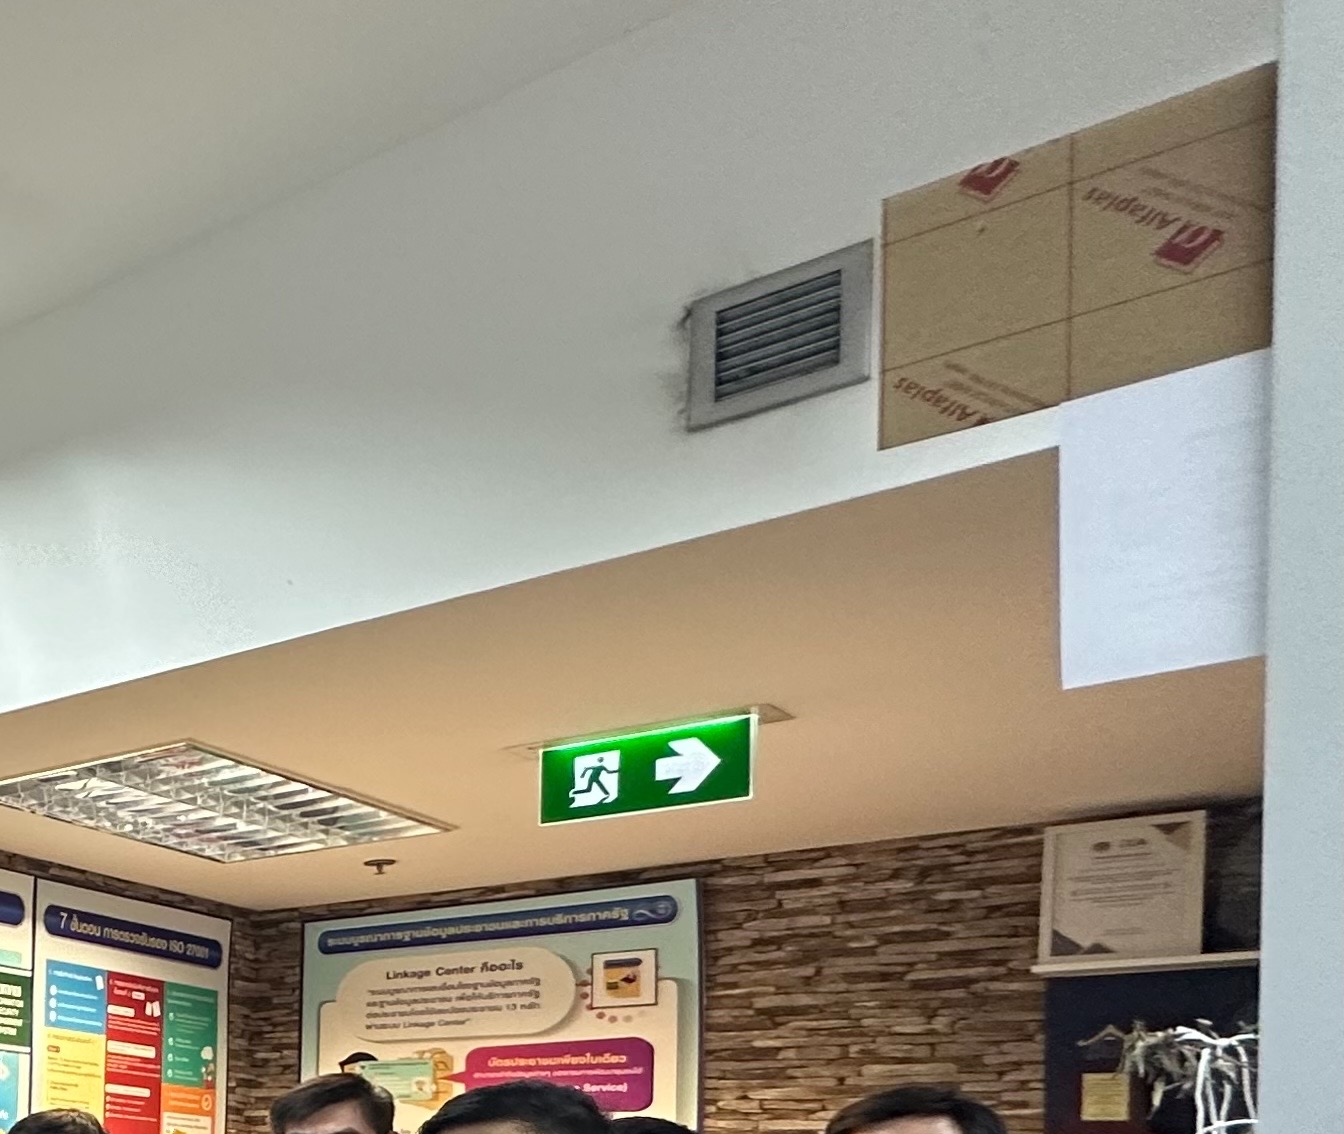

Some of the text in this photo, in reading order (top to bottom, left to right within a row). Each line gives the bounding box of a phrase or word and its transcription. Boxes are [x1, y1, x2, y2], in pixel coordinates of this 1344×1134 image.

[1082, 185, 1178, 231] Alfaplas
[892, 375, 976, 423] Alfaplas
[59, 912, 68, 929] 7
[169, 940, 184, 954] ISO
[386, 969, 431, 980] Linkage
[436, 965, 476, 977] Center
